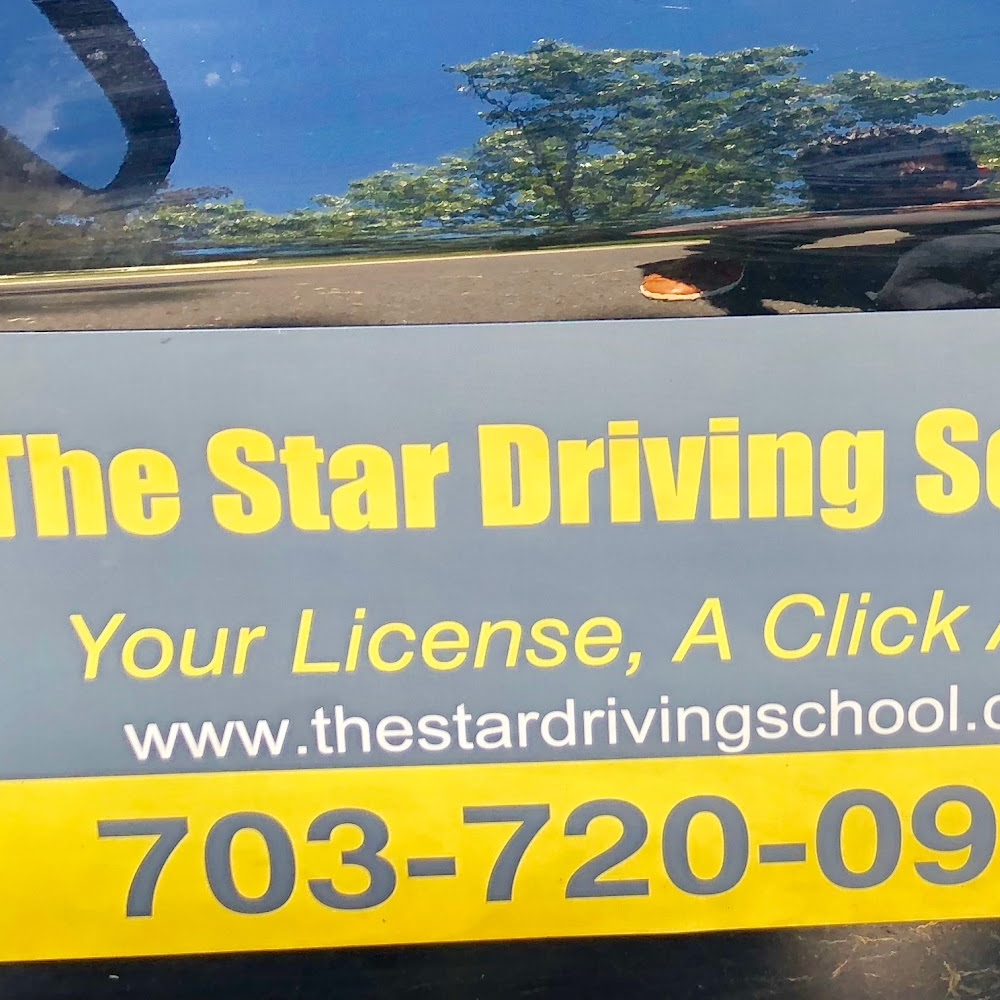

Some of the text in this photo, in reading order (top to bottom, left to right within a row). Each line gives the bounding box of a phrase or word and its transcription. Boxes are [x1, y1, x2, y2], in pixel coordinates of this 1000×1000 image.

[207, 427, 449, 535] Star
[478, 417, 886, 530] Driving
[69, 612, 266, 680] Your
[292, 608, 643, 675] License,
[671, 597, 732, 662] A
[763, 588, 970, 660] Click
